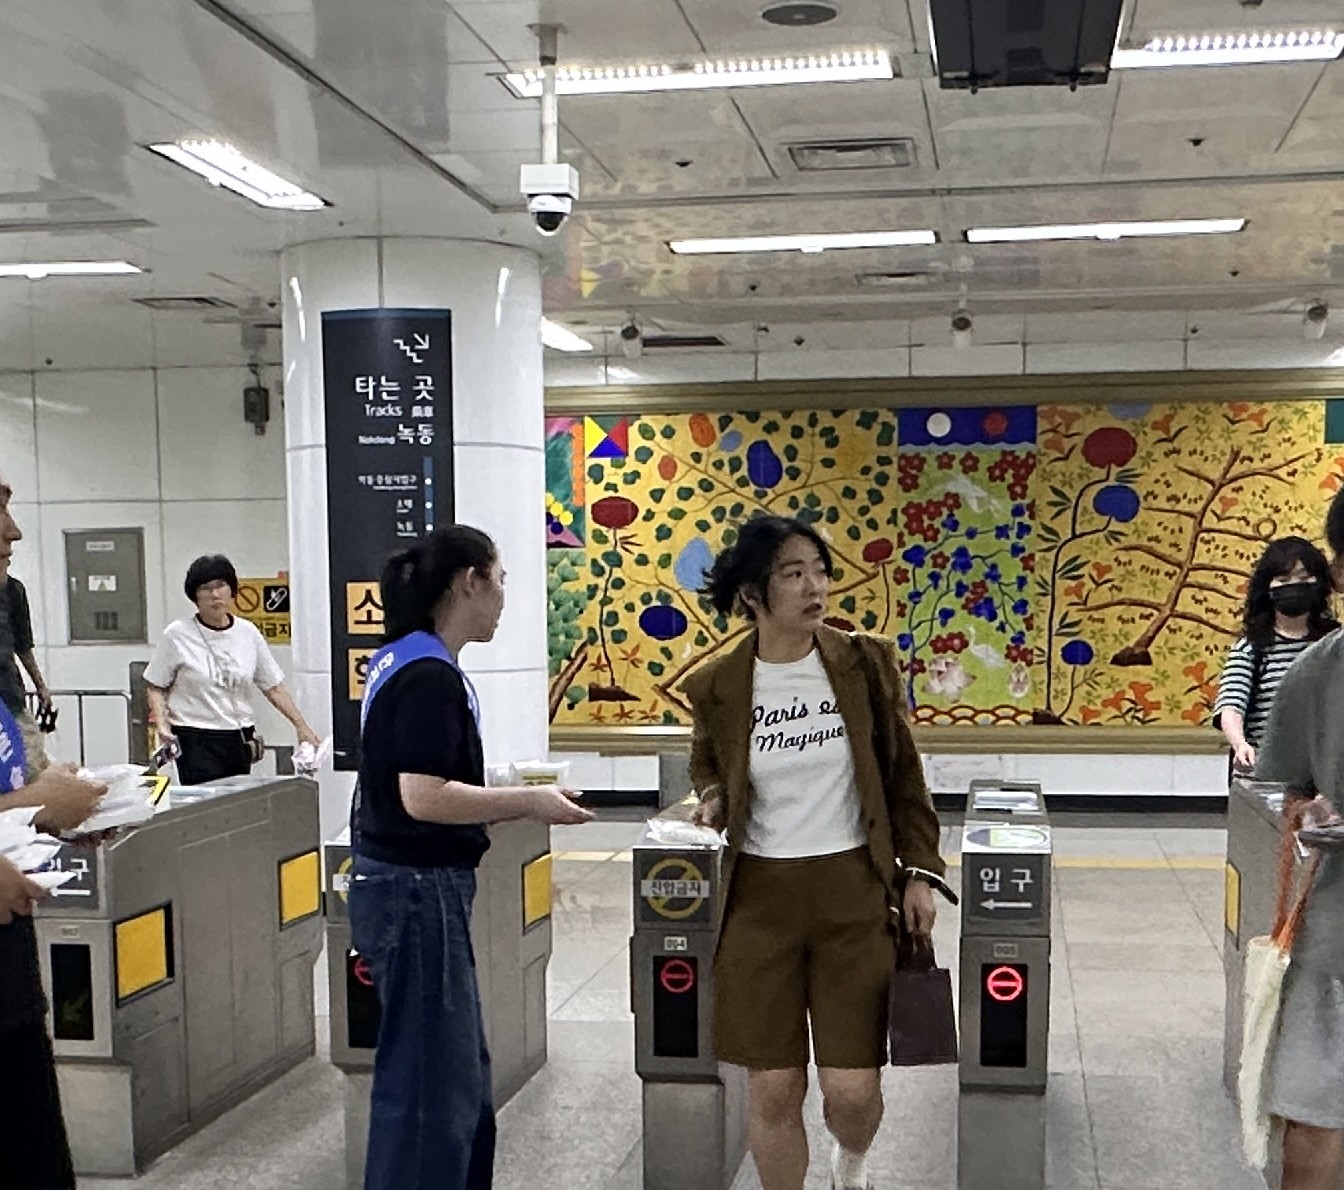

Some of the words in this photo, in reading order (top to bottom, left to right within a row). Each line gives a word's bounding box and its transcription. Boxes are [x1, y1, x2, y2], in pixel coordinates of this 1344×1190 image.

[355, 375, 401, 401] 타는
[413, 375, 435, 401] 곳
[364, 404, 403, 417] Tracks
[396, 423, 435, 445] 녹동
[750, 696, 809, 733] Paris
[756, 725, 844, 752] Magique
[979, 867, 1034, 893] 입구
